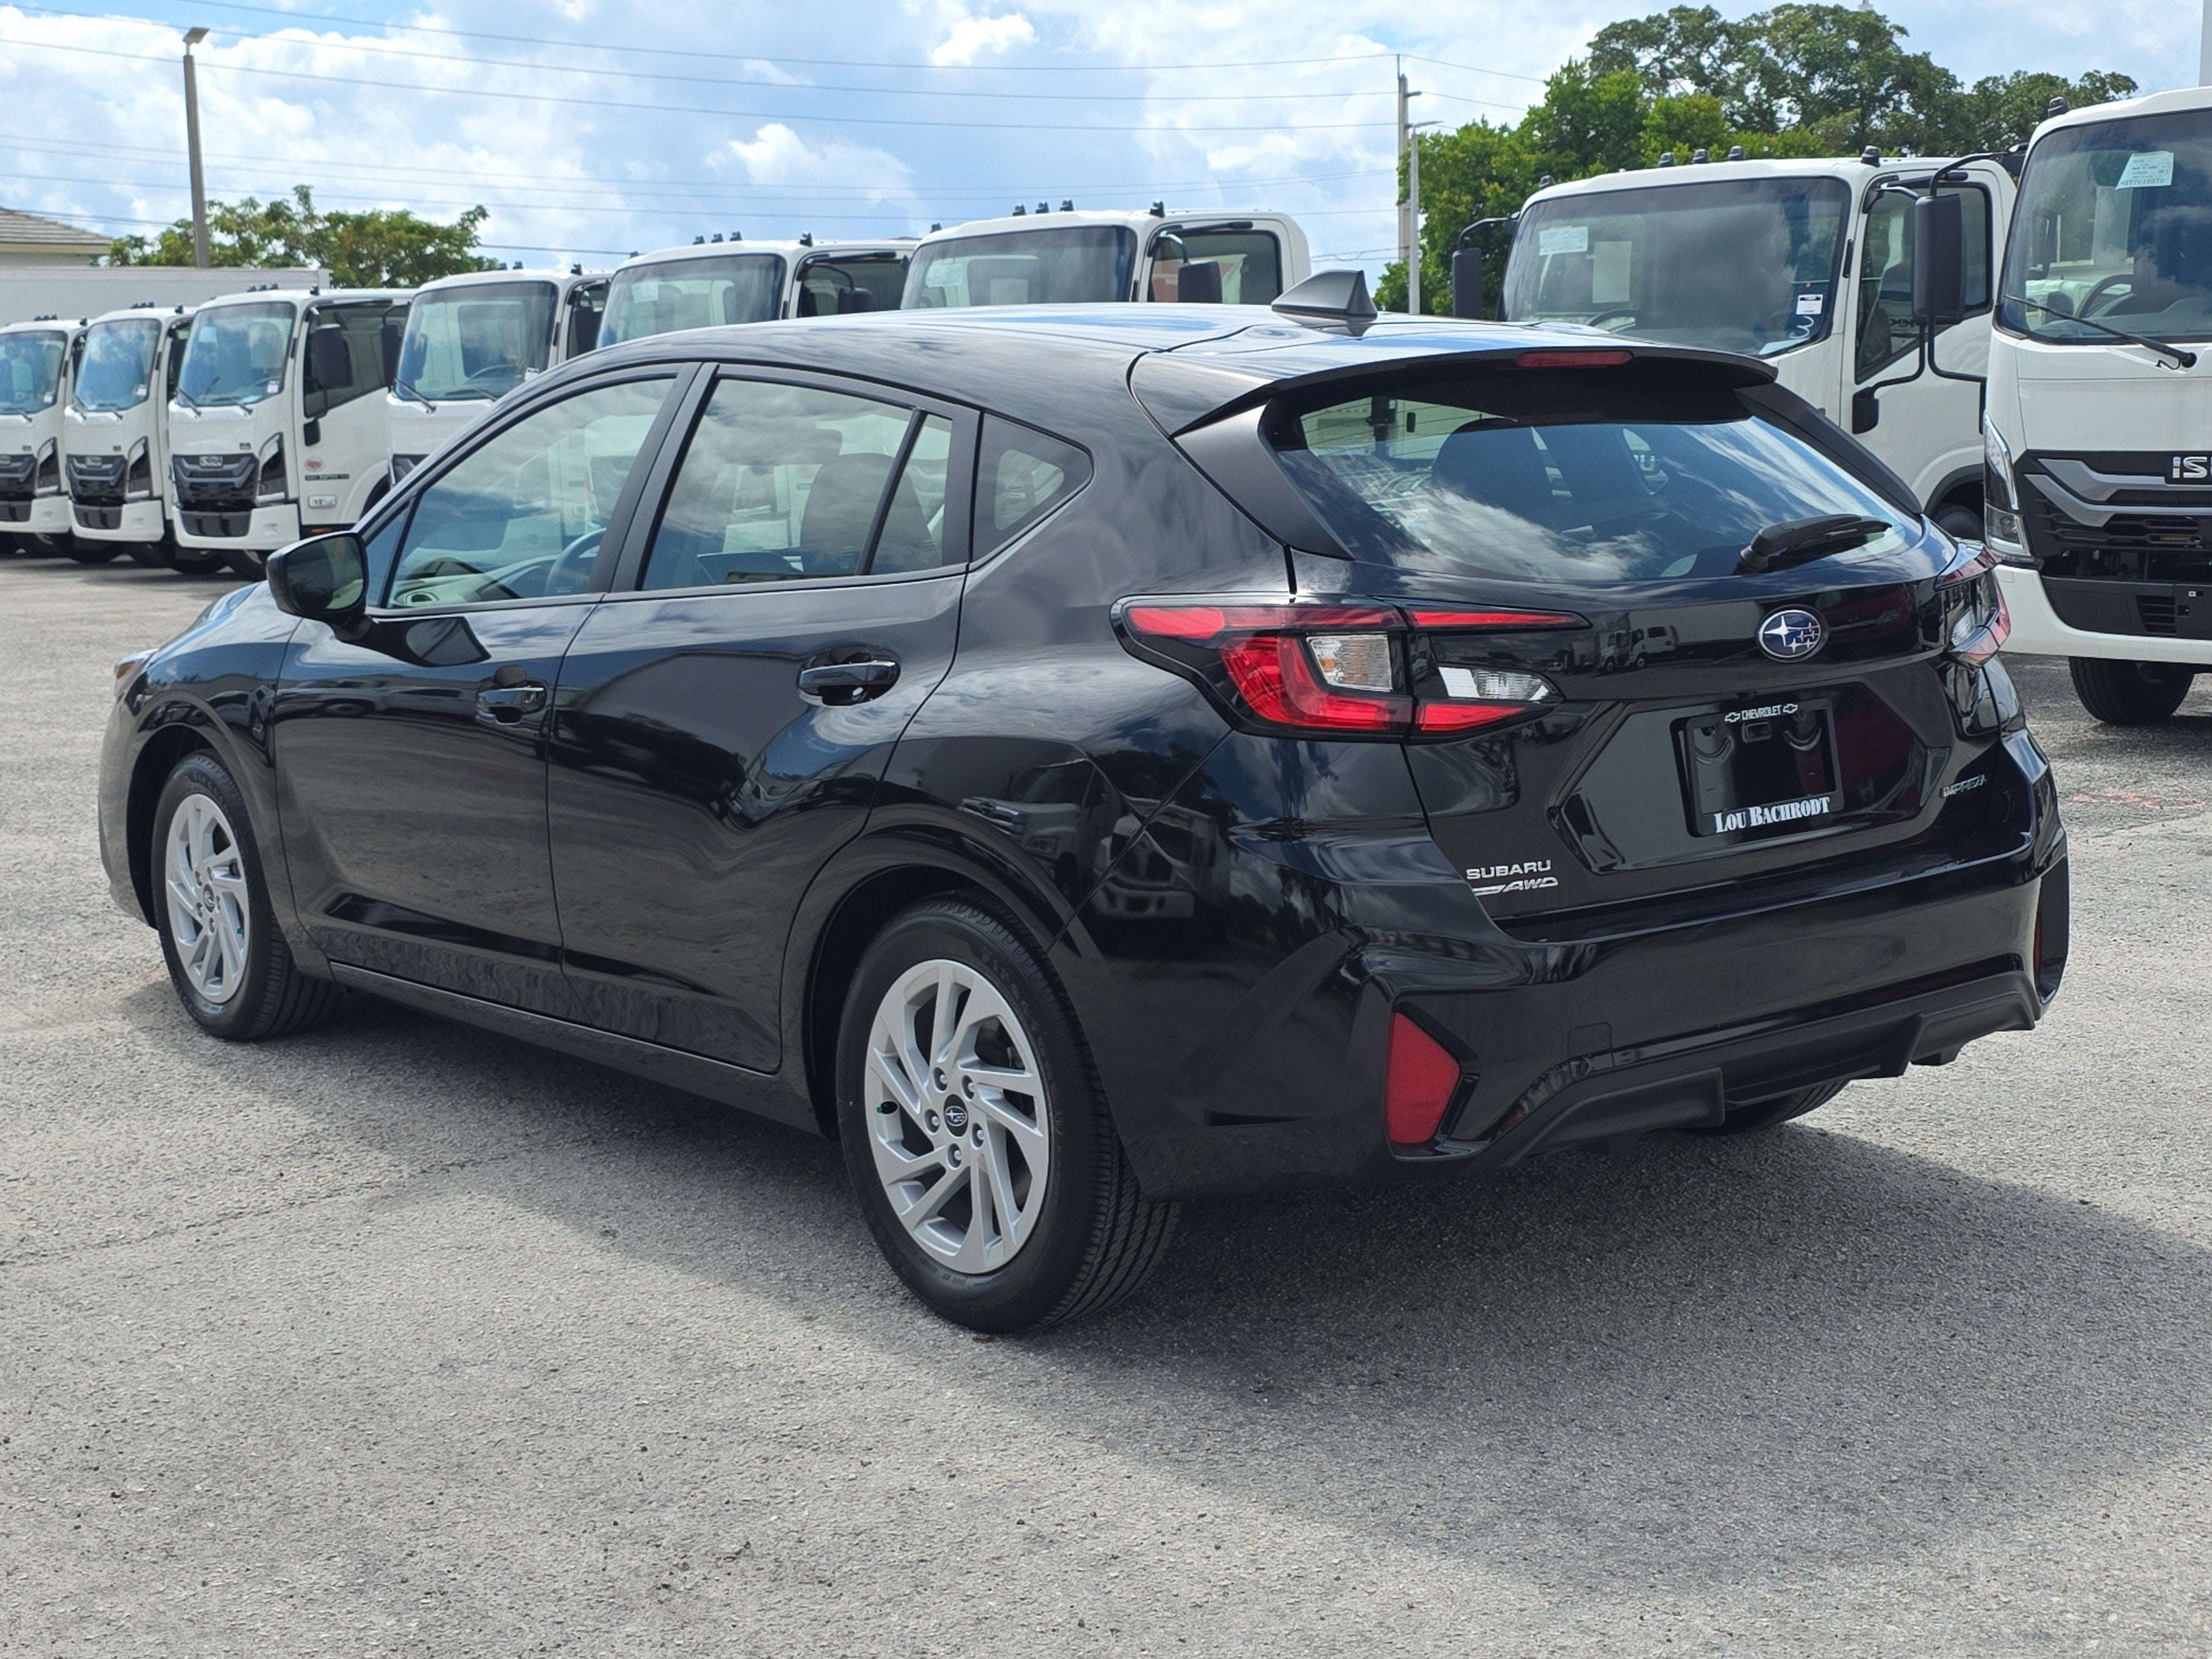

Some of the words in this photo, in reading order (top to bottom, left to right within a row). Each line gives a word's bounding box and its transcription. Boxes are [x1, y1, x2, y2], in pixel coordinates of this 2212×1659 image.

[2172, 456, 2212, 478] IS
[1741, 705, 1782, 721] CHEVROLET
[1465, 859, 1551, 880] SUBARU
